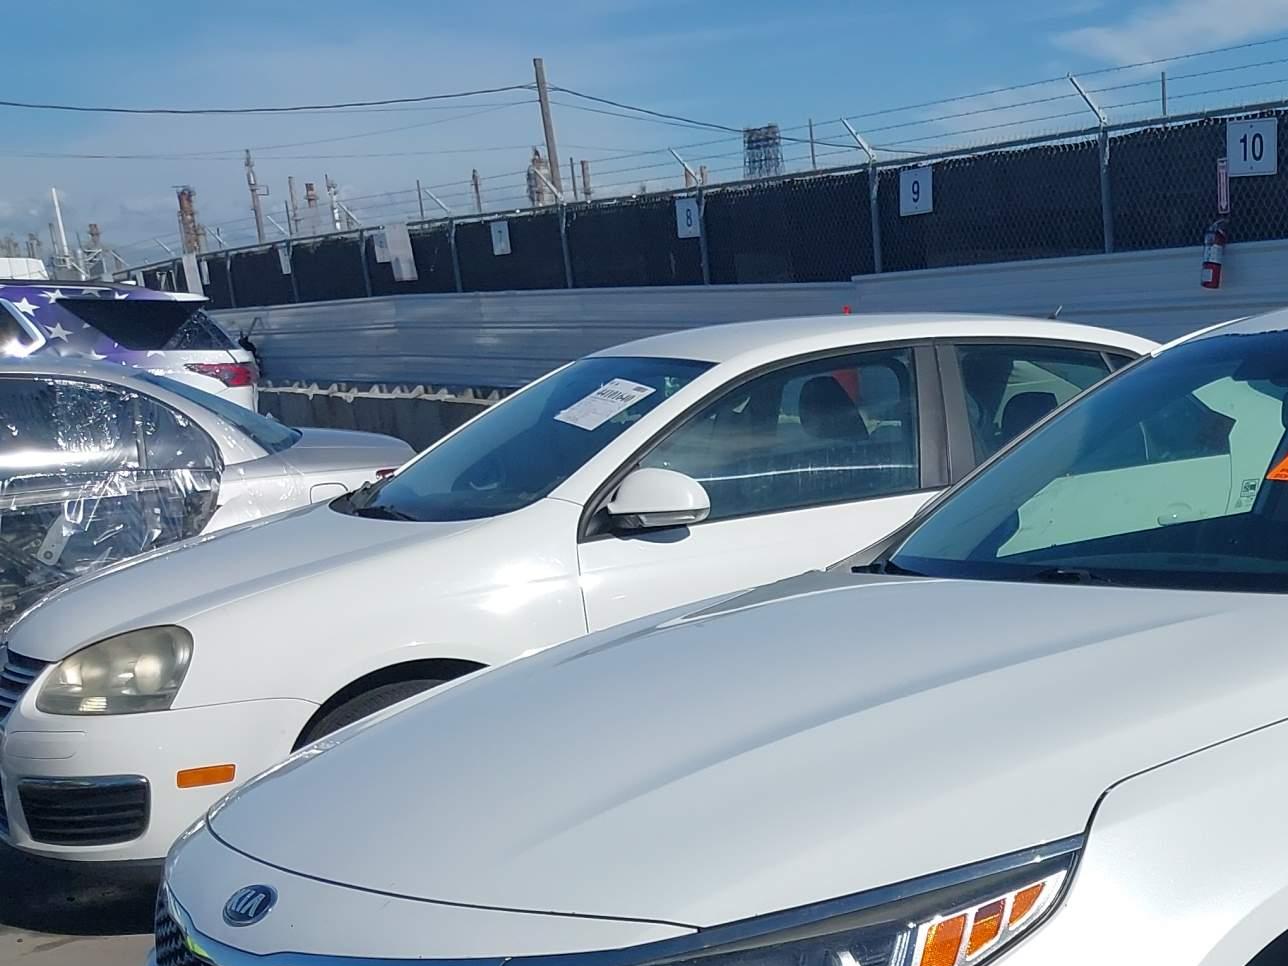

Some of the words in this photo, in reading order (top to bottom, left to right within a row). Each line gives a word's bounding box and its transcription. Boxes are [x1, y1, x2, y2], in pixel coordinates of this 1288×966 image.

[1239, 132, 1265, 162] 10
[911, 179, 920, 203] 9
[686, 208, 693, 228] 8
